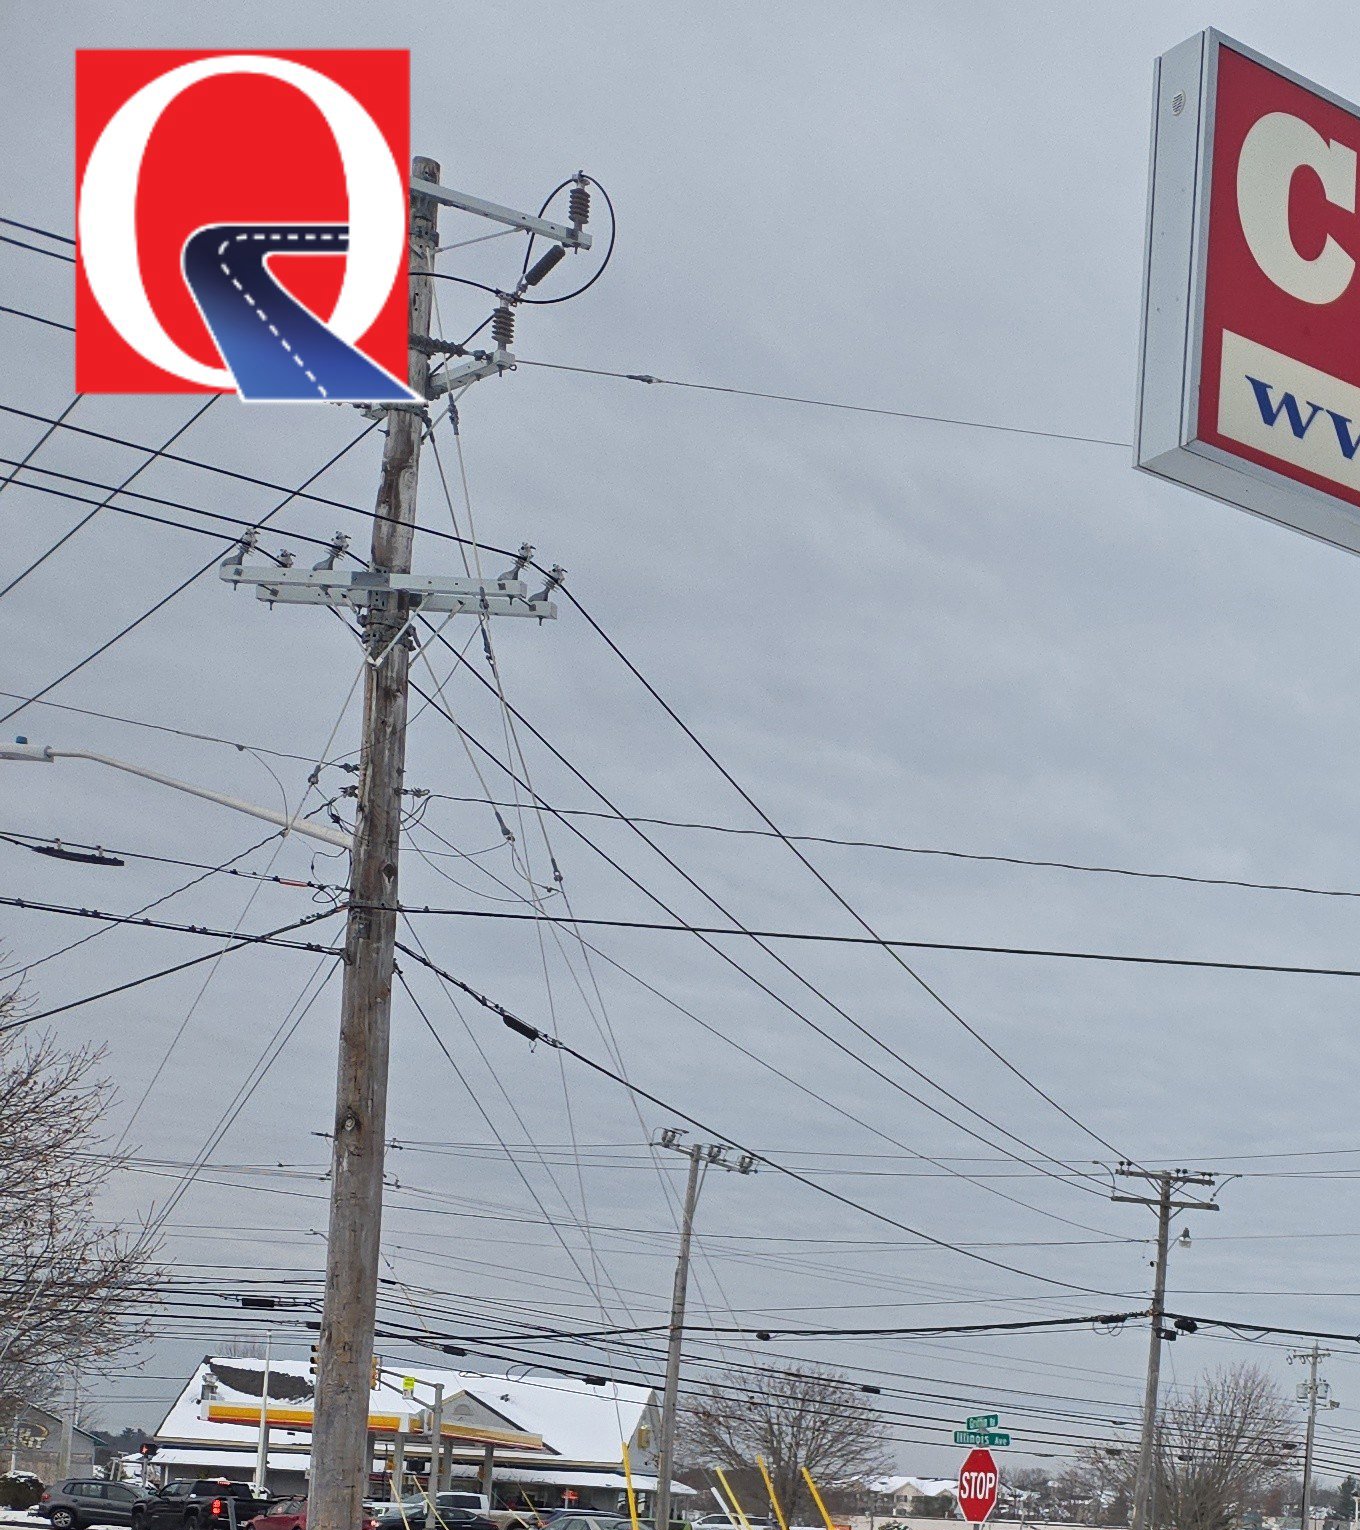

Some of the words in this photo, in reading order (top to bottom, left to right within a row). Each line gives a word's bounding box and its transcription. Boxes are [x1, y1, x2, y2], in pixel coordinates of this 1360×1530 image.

[956, 1431, 989, 1445] Illinois
[994, 1436, 1008, 1446] Ave
[960, 1471, 996, 1500] STOP
